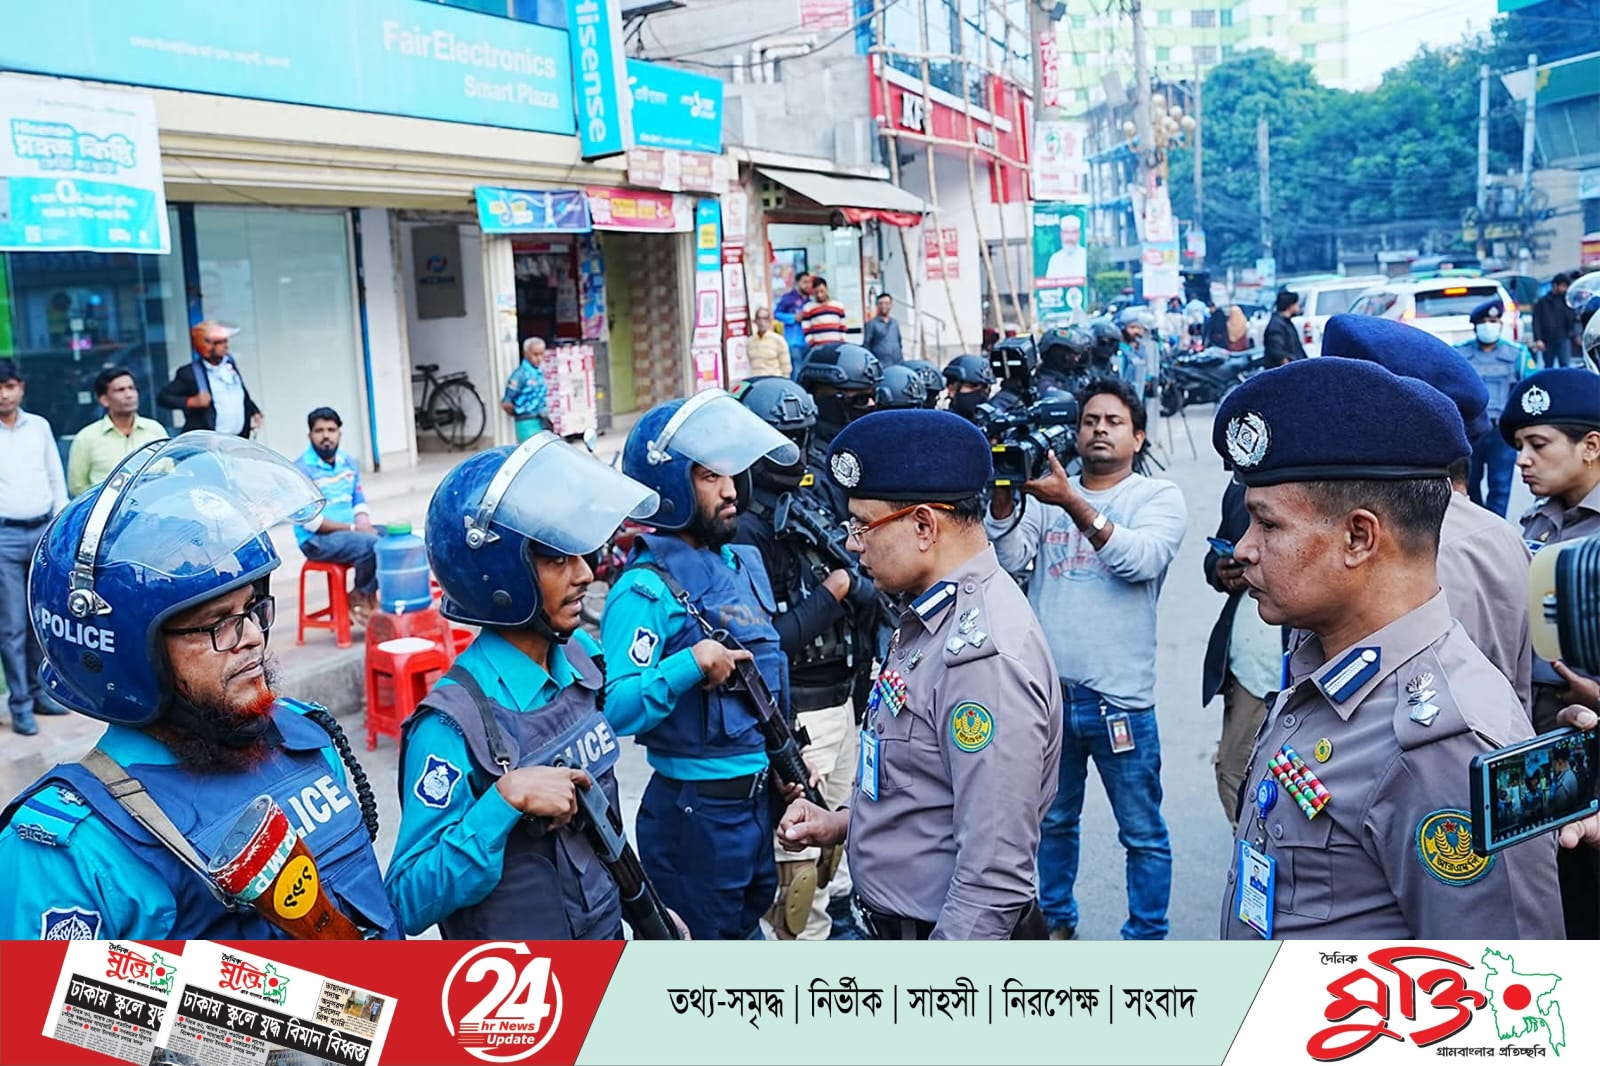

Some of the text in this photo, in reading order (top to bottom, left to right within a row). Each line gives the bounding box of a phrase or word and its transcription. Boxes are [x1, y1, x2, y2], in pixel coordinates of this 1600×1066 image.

[383, 20, 556, 79] FairElectronics
[574, 0, 607, 143] Hisense
[464, 75, 559, 110] Smart Plaza
[41, 607, 115, 653] POLICE
